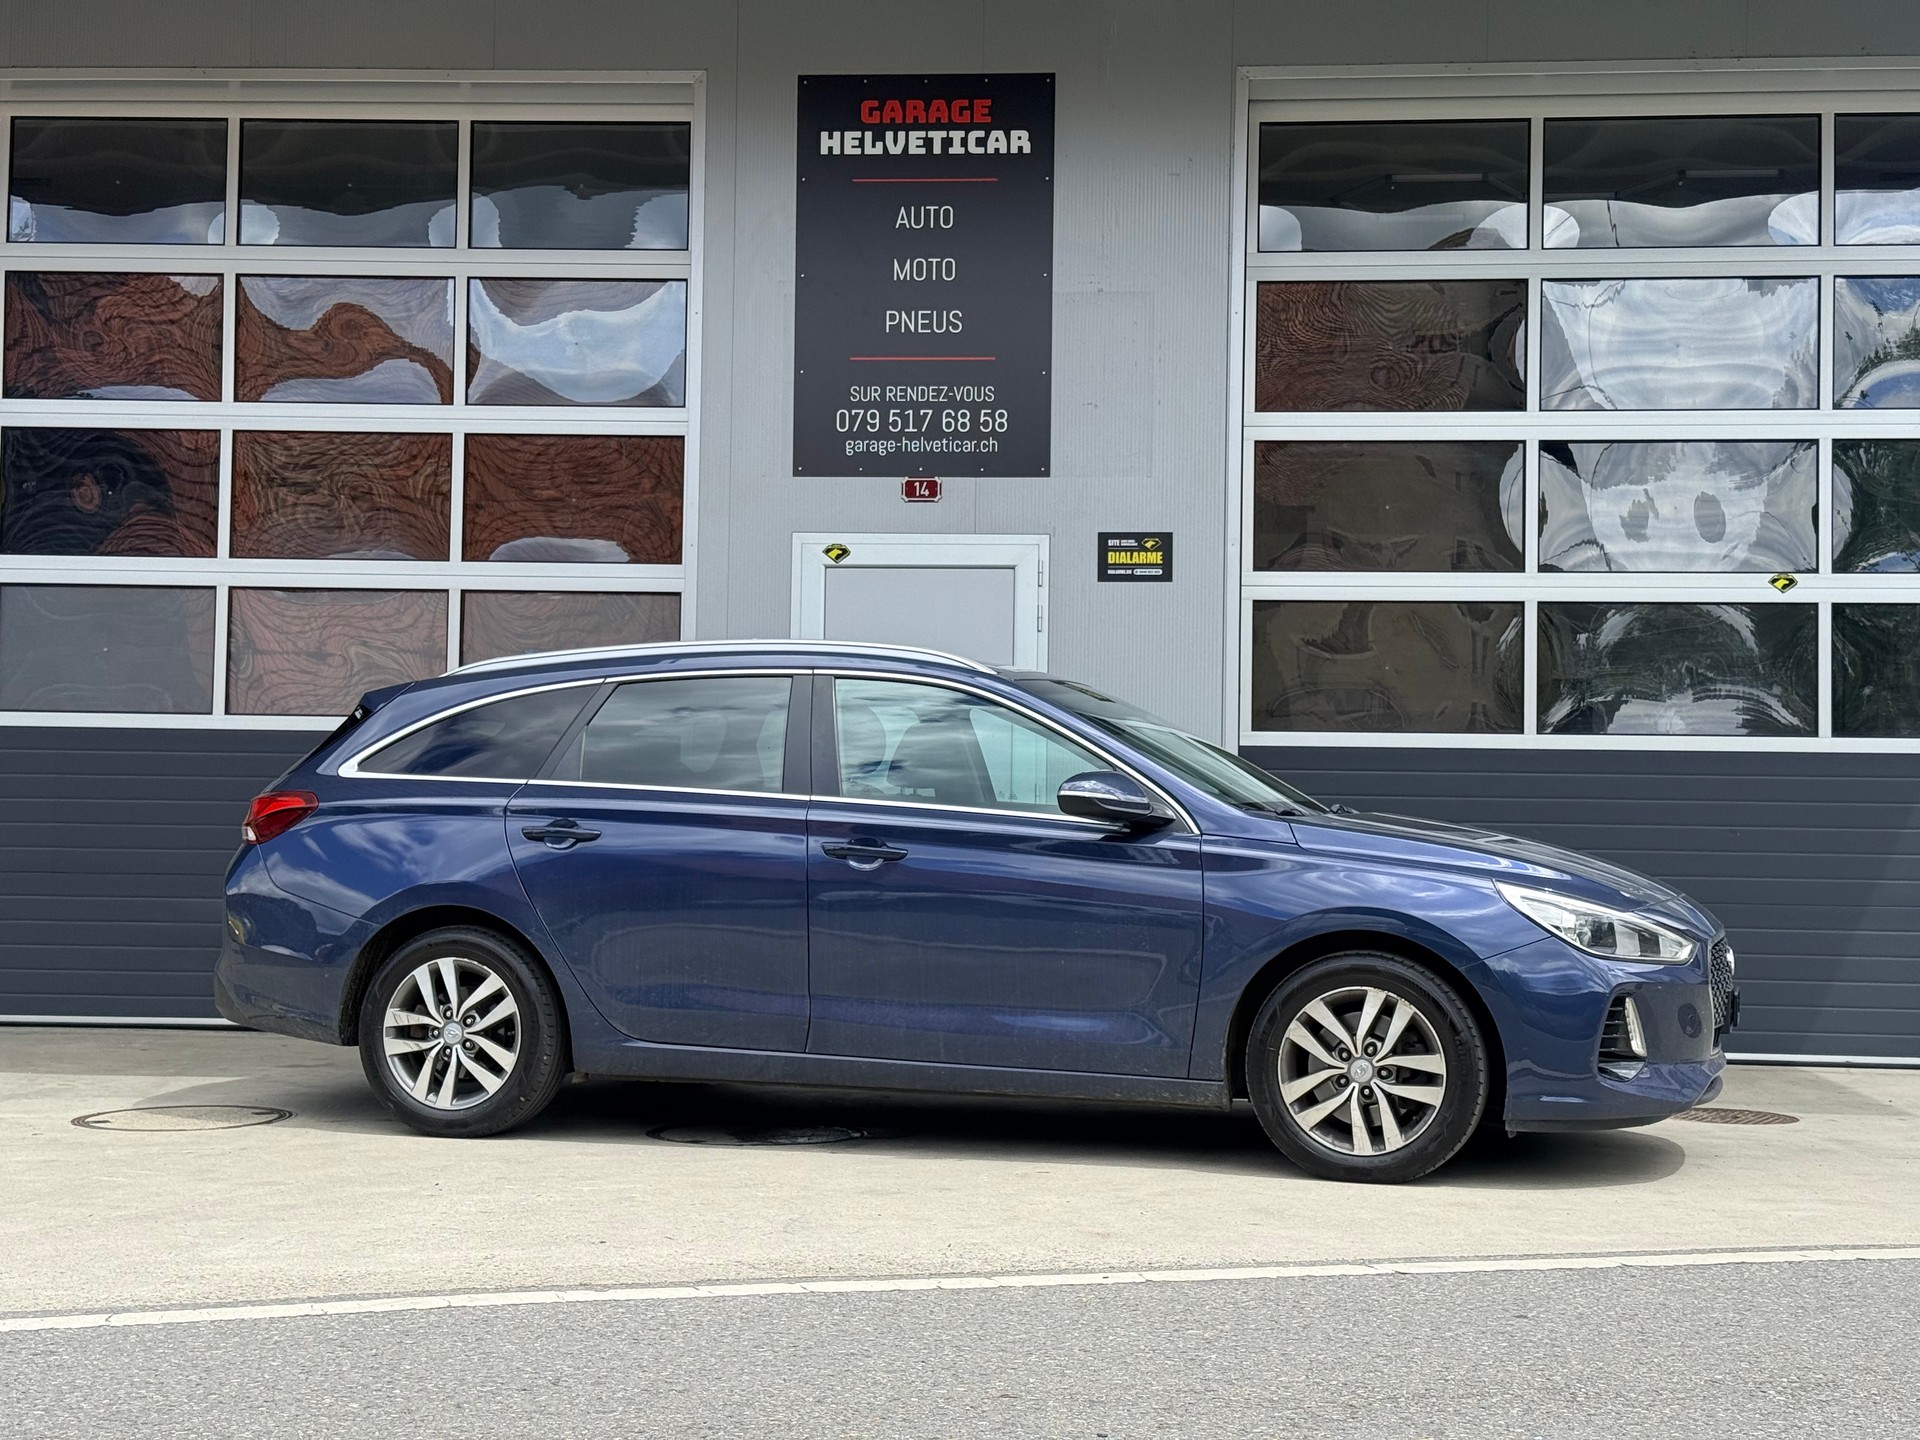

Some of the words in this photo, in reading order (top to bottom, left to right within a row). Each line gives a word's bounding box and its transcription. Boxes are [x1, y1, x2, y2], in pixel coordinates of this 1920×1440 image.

[860, 99, 992, 124] GARAGE
[820, 130, 1031, 155] HELVETICAR
[895, 206, 954, 228] AUTO
[893, 258, 956, 281] MOTO
[885, 310, 963, 333] PNEUS
[850, 386, 881, 402] SUR
[886, 386, 995, 402] RENDEZ-VOUS
[835, 409, 880, 432] 079
[888, 409, 933, 432] 517
[941, 409, 970, 432] 68
[979, 409, 1008, 432] 58
[845, 437, 998, 456] garage-helveticar.ch
[913, 481, 930, 497] 14
[1107, 551, 1163, 564] DIALARME
